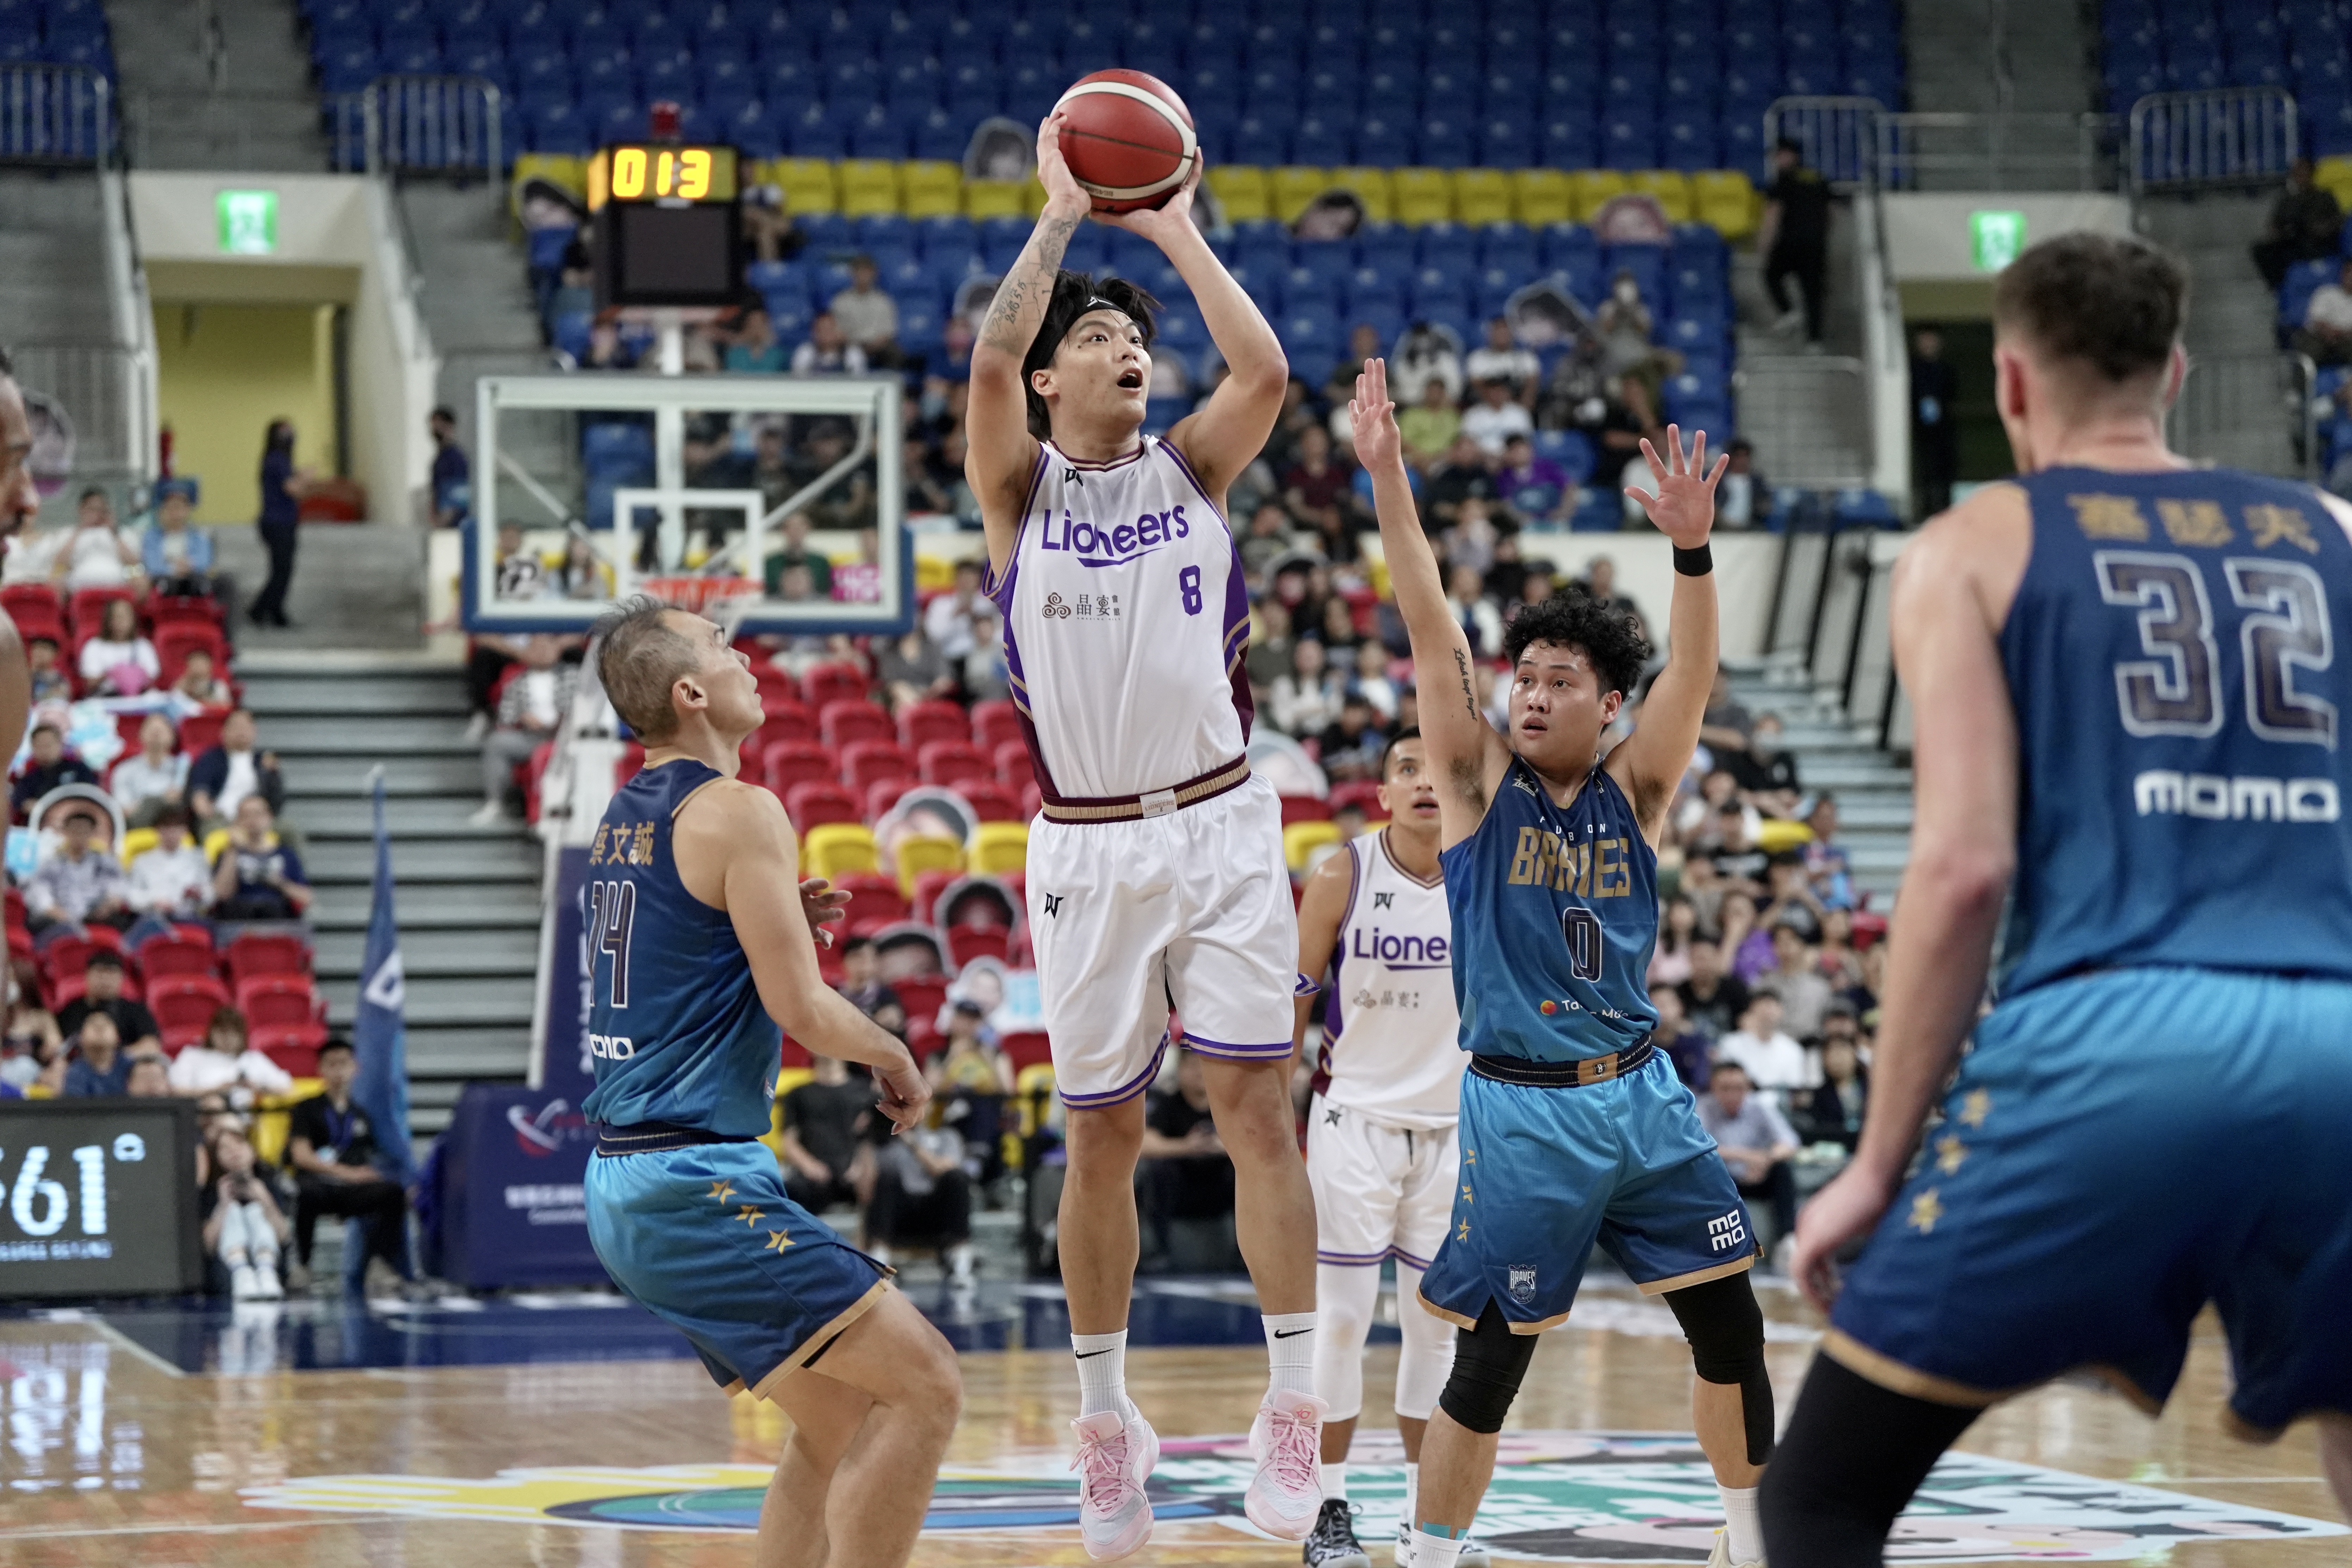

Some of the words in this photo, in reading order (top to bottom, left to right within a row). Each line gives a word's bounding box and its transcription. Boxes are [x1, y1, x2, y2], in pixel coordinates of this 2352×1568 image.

[1042, 505, 1189, 557] Lioneers
[1179, 565, 1202, 616] 8
[2092, 549, 2338, 752] 32
[2133, 770, 2341, 822] momo
[1540, 816, 1606, 841] FUBON
[1508, 826, 1630, 898] BRAVES
[589, 880, 636, 1008] 14
[1354, 927, 1452, 961] Lione
[1563, 907, 1602, 983] 0
[1510, 1270, 1535, 1290] BRAVES
